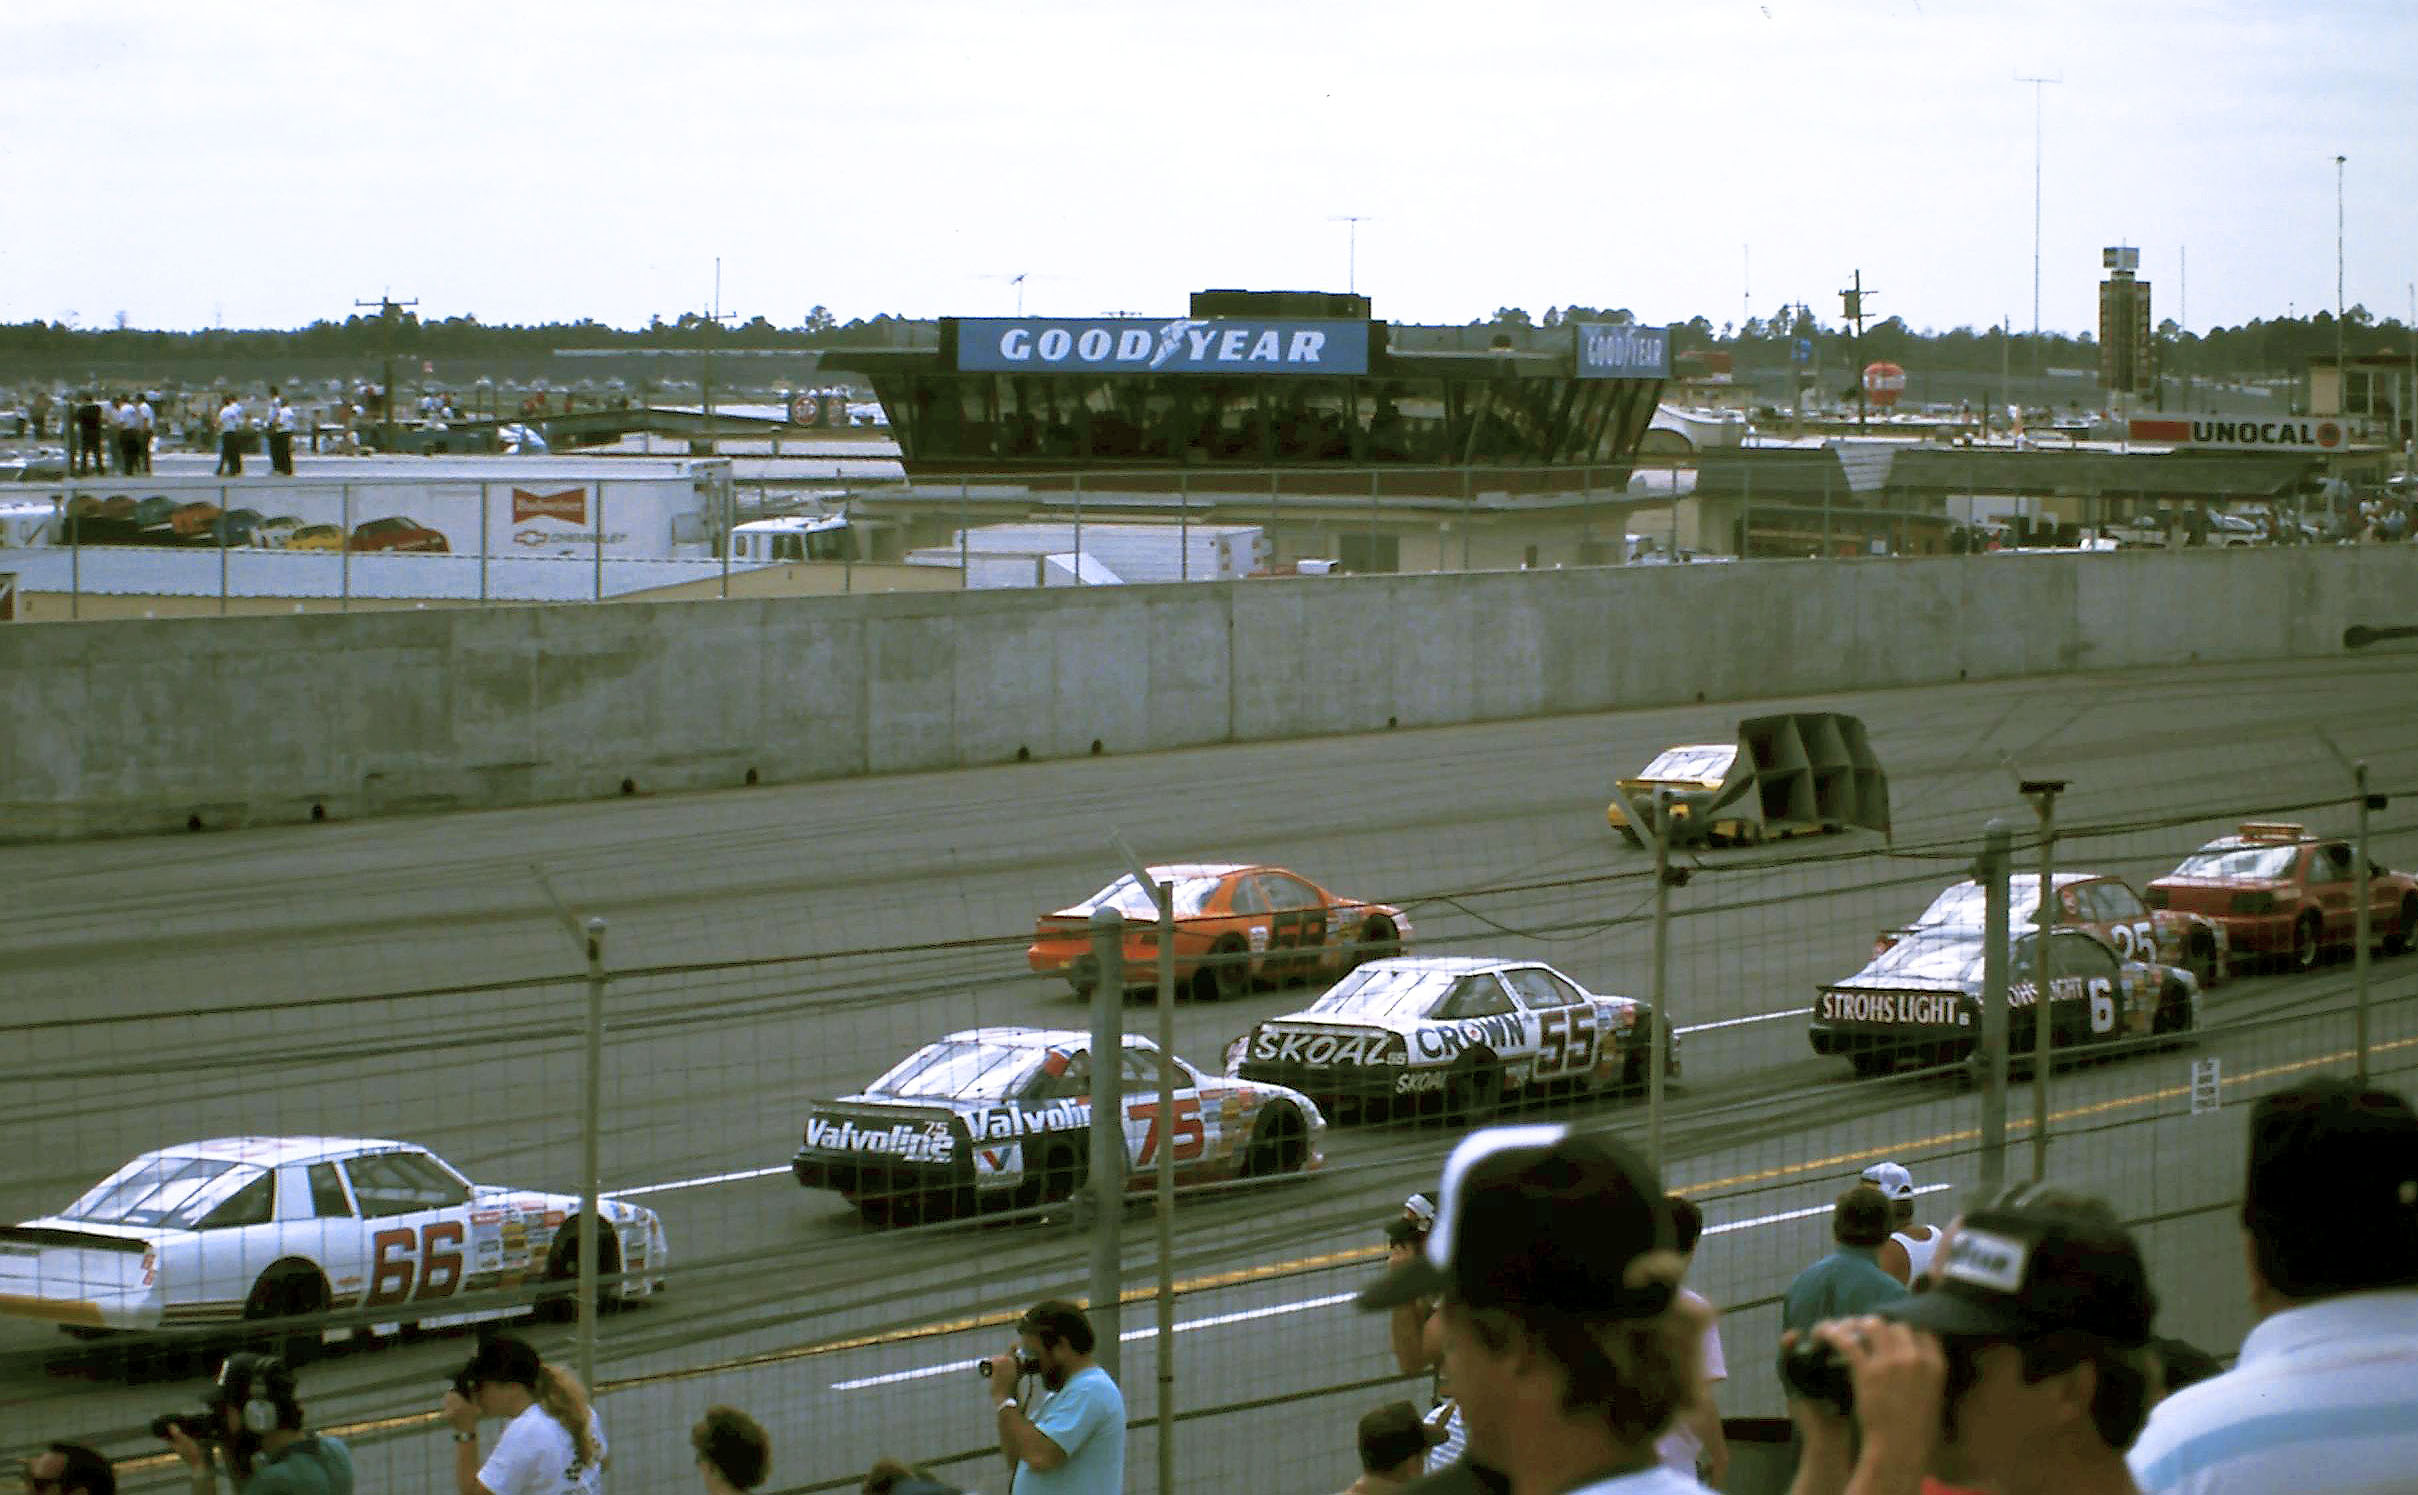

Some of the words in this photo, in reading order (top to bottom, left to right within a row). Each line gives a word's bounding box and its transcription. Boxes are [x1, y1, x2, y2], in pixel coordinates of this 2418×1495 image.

[1000, 325, 1326, 366] GOODYEAR
[2192, 421, 2314, 445] UNOCAL
[1822, 992, 1895, 1023] STROHS
[1899, 995, 1959, 1024] LIGHT
[2088, 976, 2115, 1034] 6
[1254, 1033, 1392, 1067] SKOAL
[1416, 1012, 1526, 1060] CROWN
[1535, 1004, 1598, 1081] 55
[806, 1117, 956, 1163] Valvoline
[961, 1098, 1091, 1142] Valvolin
[1126, 1099, 1205, 1167] 75
[367, 1220, 464, 1306] 66
